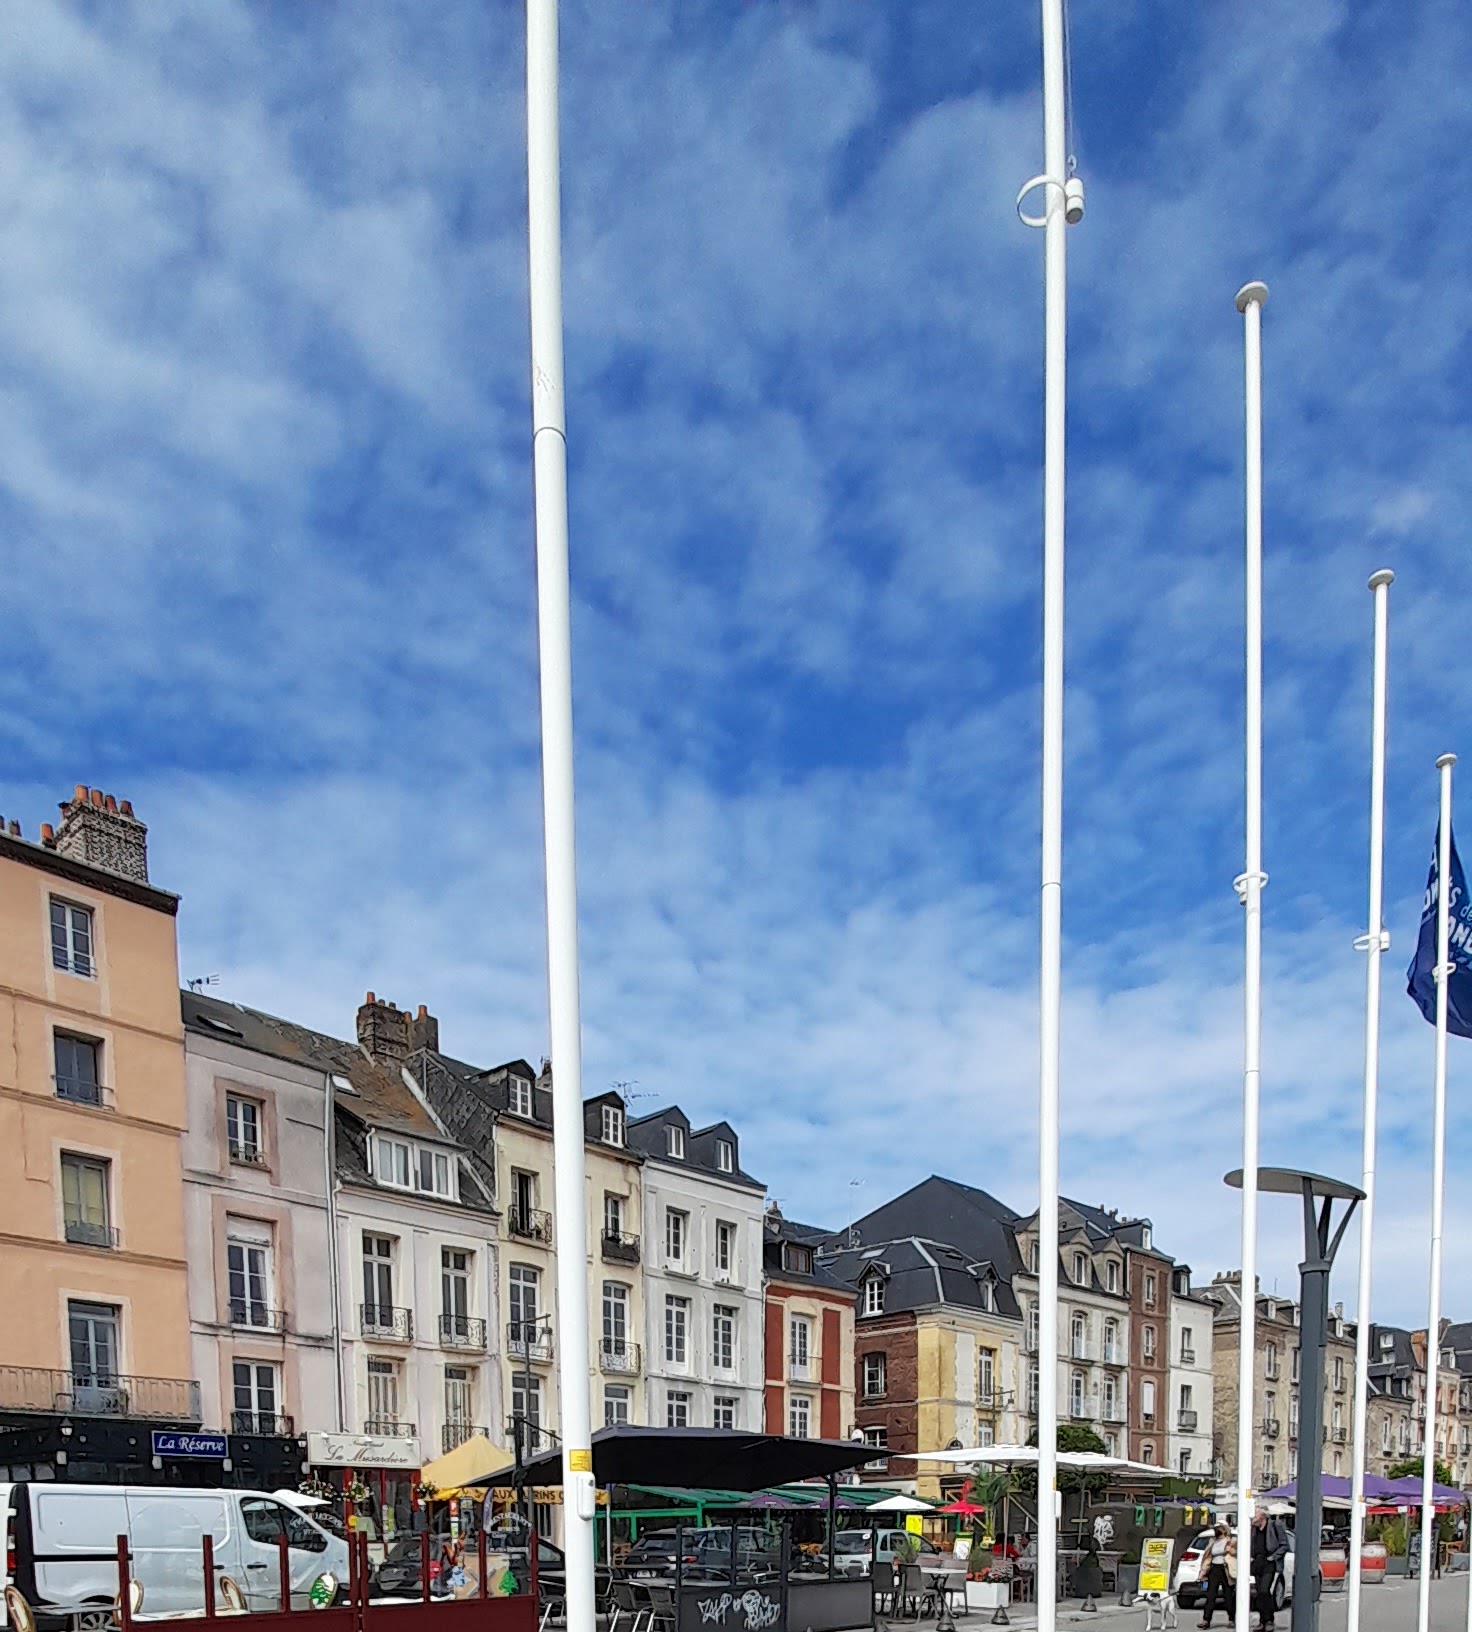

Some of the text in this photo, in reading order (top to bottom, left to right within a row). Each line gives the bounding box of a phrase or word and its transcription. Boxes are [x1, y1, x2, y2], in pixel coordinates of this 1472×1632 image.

[156, 1435, 225, 1453] La Réserve
[492, 1488, 514, 1500] AUX
